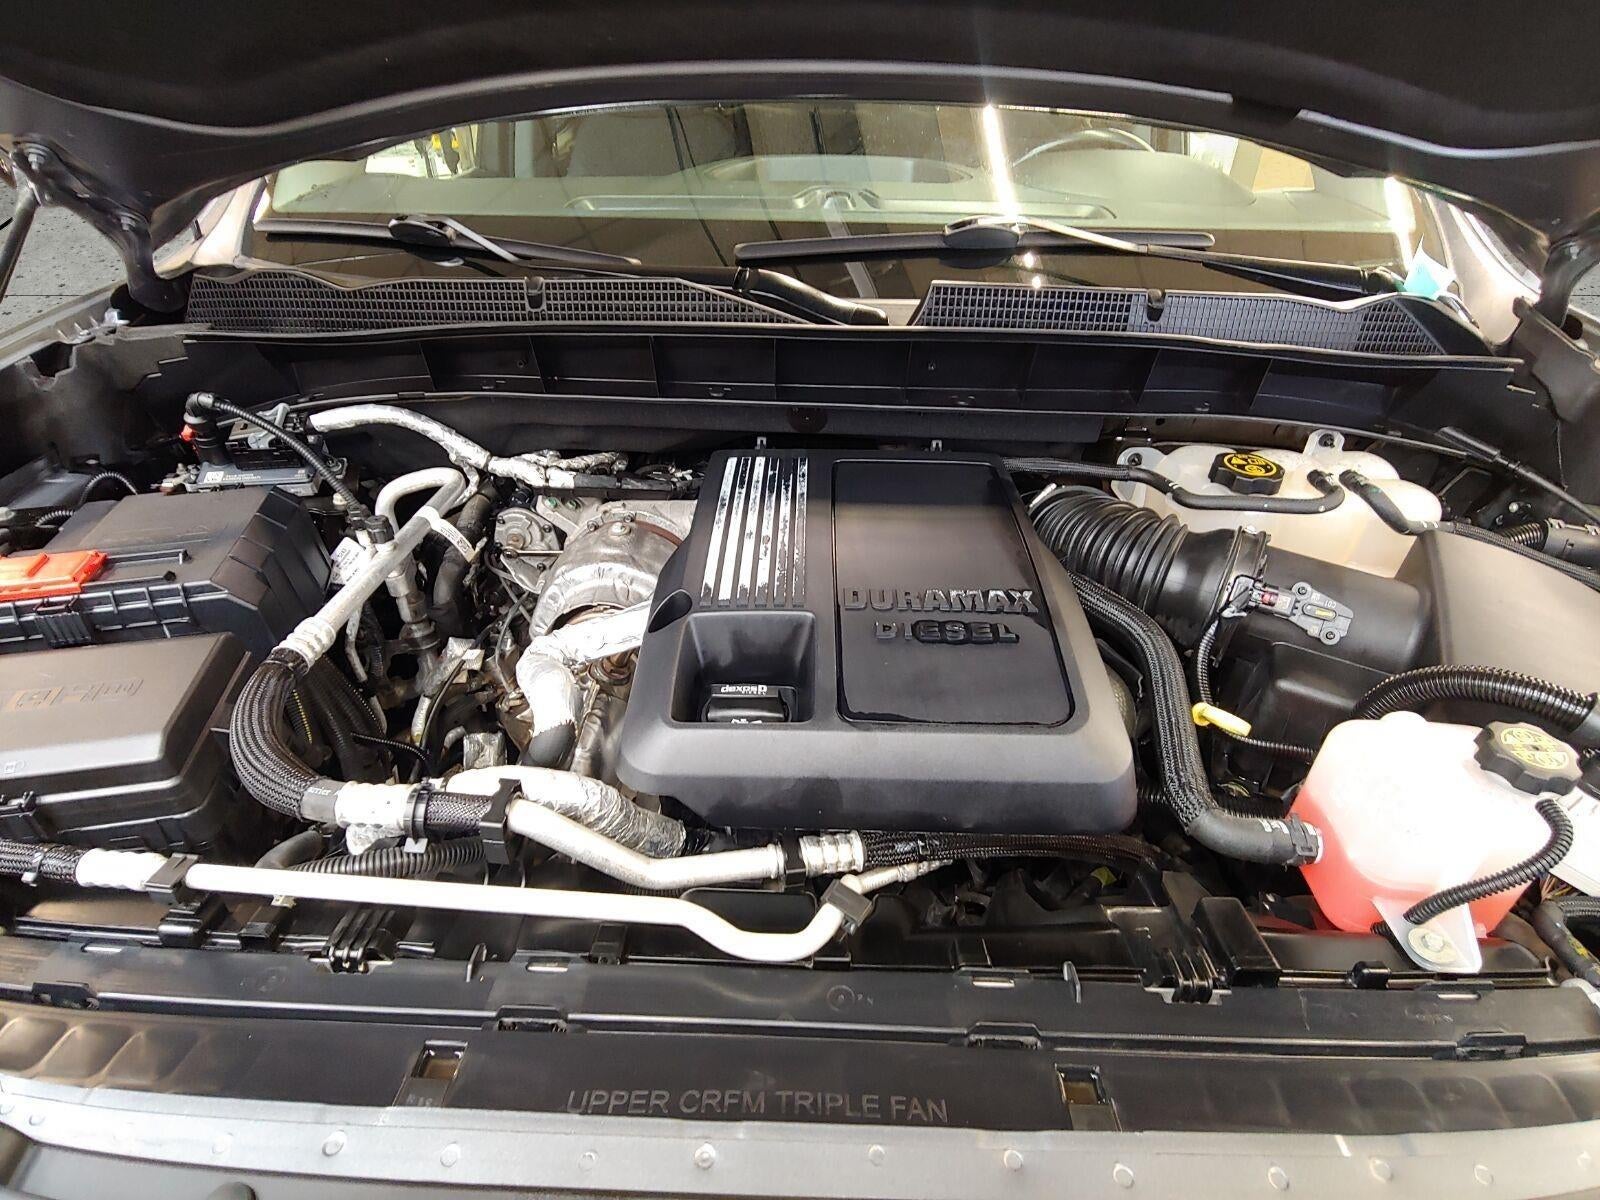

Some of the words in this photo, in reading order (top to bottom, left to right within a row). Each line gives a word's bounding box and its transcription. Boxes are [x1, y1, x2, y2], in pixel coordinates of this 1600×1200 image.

[843, 587, 1039, 614] DURAMAX
[874, 620, 1020, 644] DIESEL
[566, 1089, 670, 1115] UPPER
[679, 1089, 766, 1115] CRFM
[775, 1089, 881, 1120] TRIPLE
[889, 1095, 949, 1124] FAN
